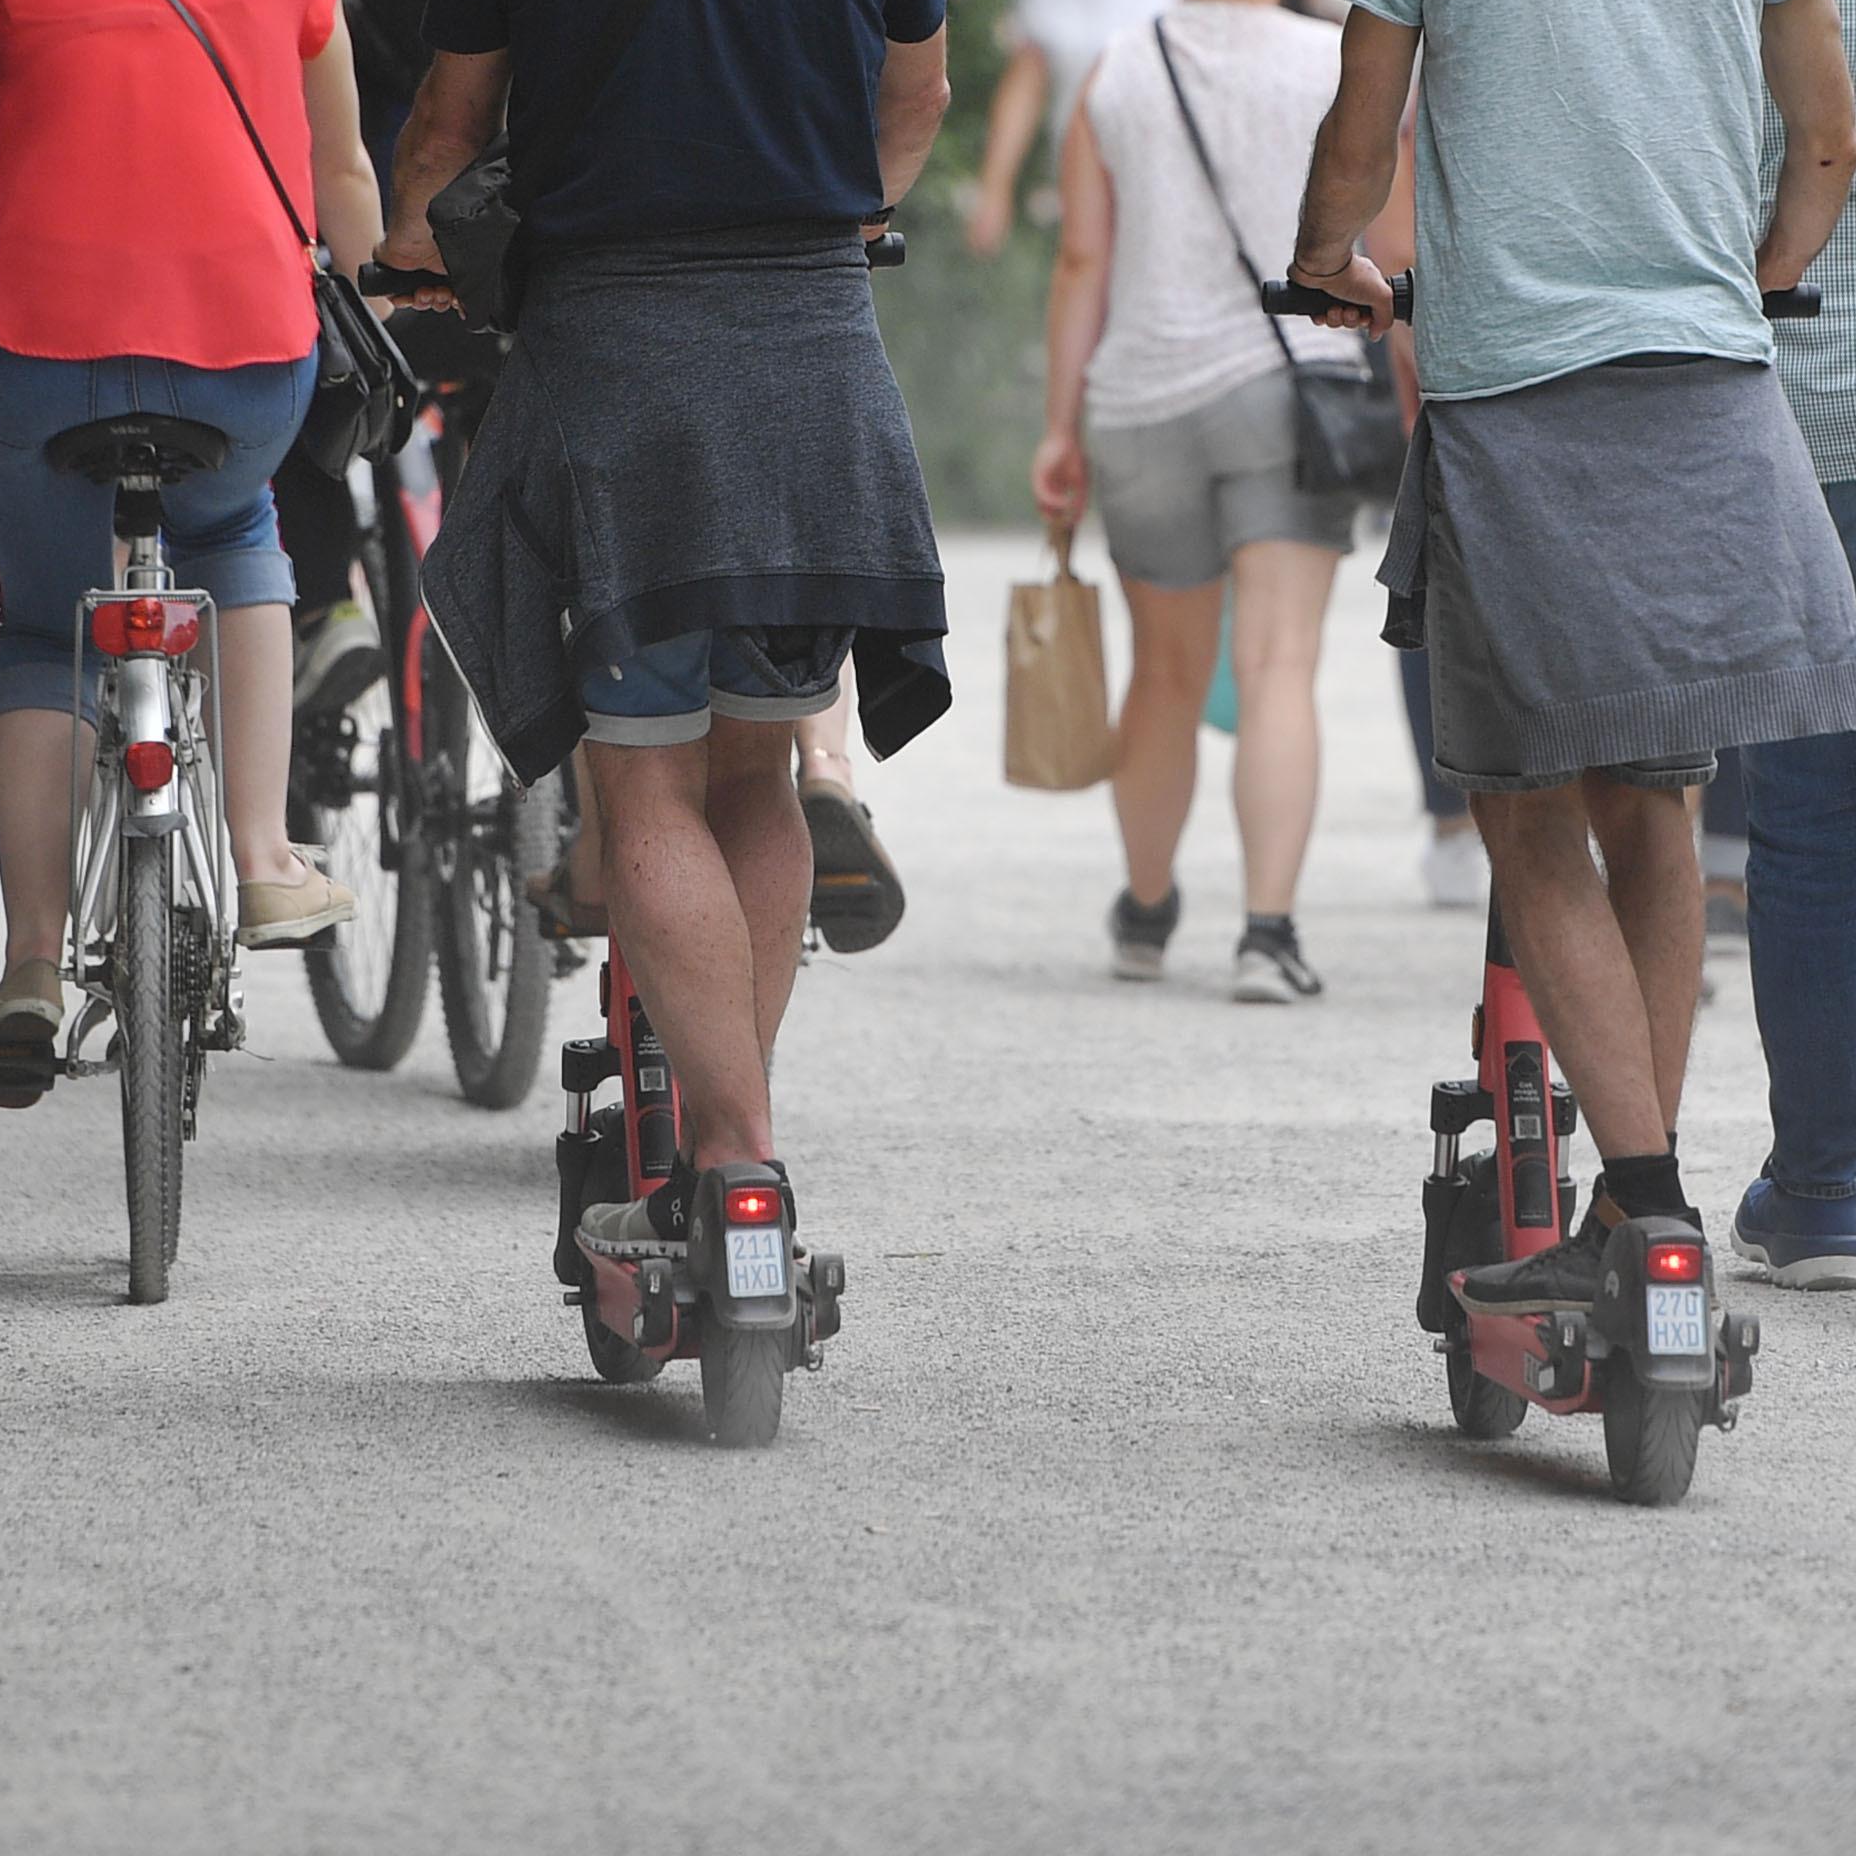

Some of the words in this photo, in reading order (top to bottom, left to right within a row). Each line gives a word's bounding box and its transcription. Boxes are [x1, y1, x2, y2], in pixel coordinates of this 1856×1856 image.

[734, 1233, 777, 1260] 211
[734, 1263, 780, 1291] HXD
[1655, 1290, 1698, 1317] 270
[1654, 1321, 1700, 1347] HXD
